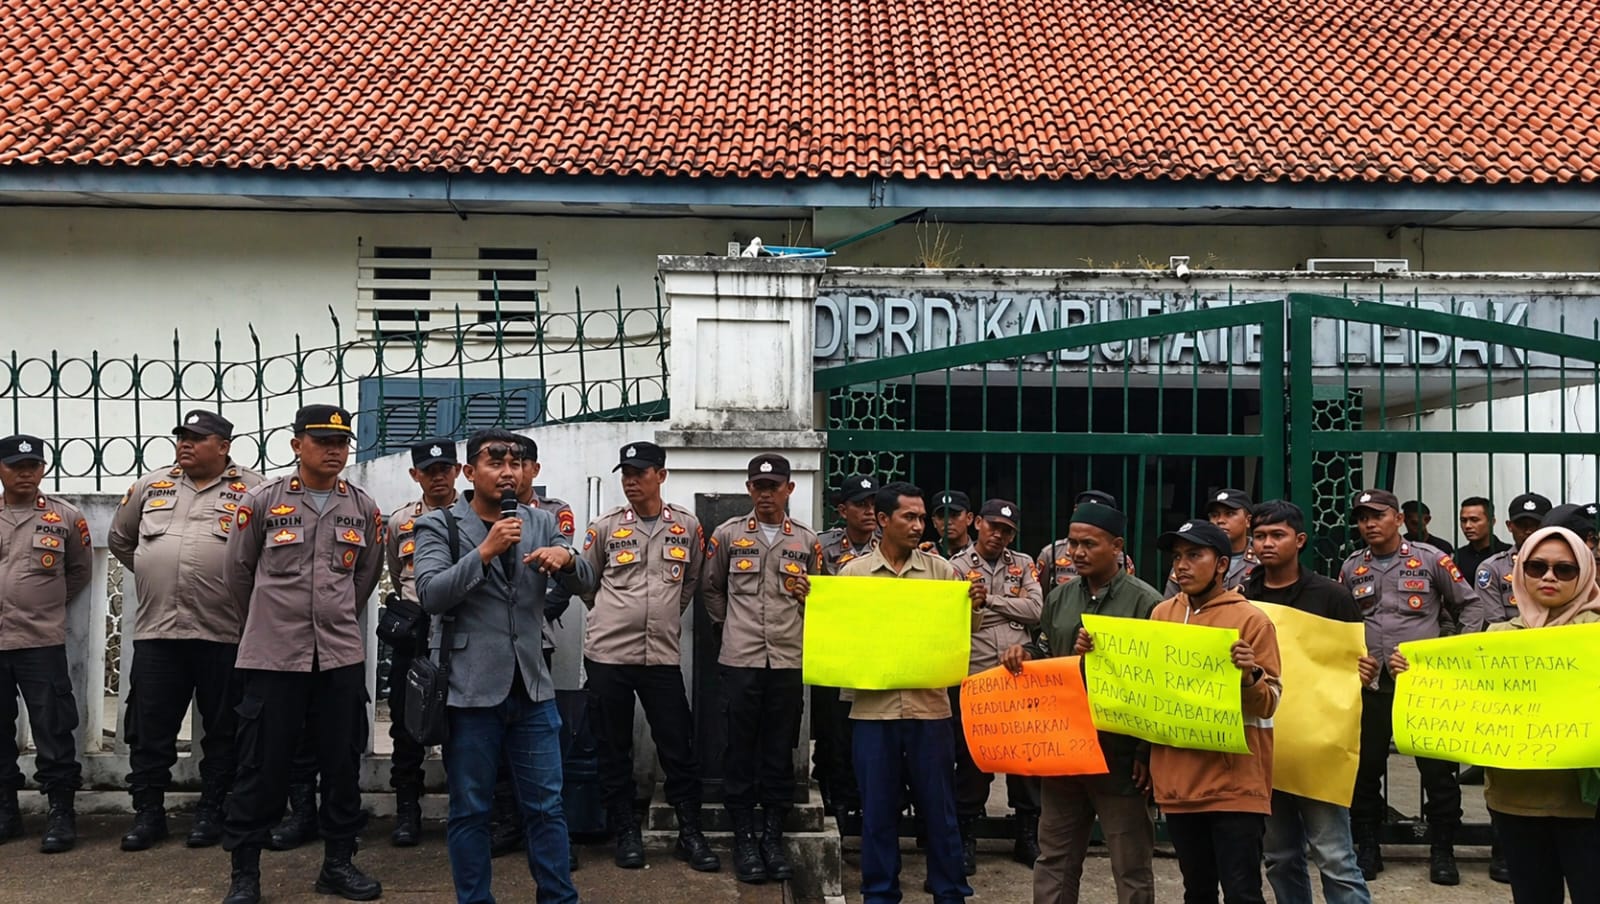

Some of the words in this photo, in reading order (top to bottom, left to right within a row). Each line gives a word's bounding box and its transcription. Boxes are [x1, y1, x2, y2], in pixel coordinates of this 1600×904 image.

[814, 297, 959, 358] DPRD
[977, 298, 1289, 362] KABUPATE
[1164, 645, 1226, 676] RUSAK
[1475, 654, 1519, 670] TAAT
[1524, 655, 1579, 671] PAJAK
[1021, 673, 1064, 691] JALAN
[1165, 672, 1228, 700] RAKYAT
[1410, 675, 1443, 690] TAPI
[1451, 678, 1495, 691] JALAN
[1503, 678, 1537, 692] KAMI
[1090, 676, 1147, 708] JANGAN
[1154, 696, 1241, 727] DIABAIKAN
[1405, 693, 1466, 712] TETAP
[972, 723, 998, 737] ATAU
[1001, 717, 1070, 735] DIBIARKAN
[1406, 713, 1465, 733] KAPAN
[1475, 721, 1515, 739] KAMI
[1527, 722, 1592, 740] DAPAT
[979, 744, 1021, 761] RUSAK
